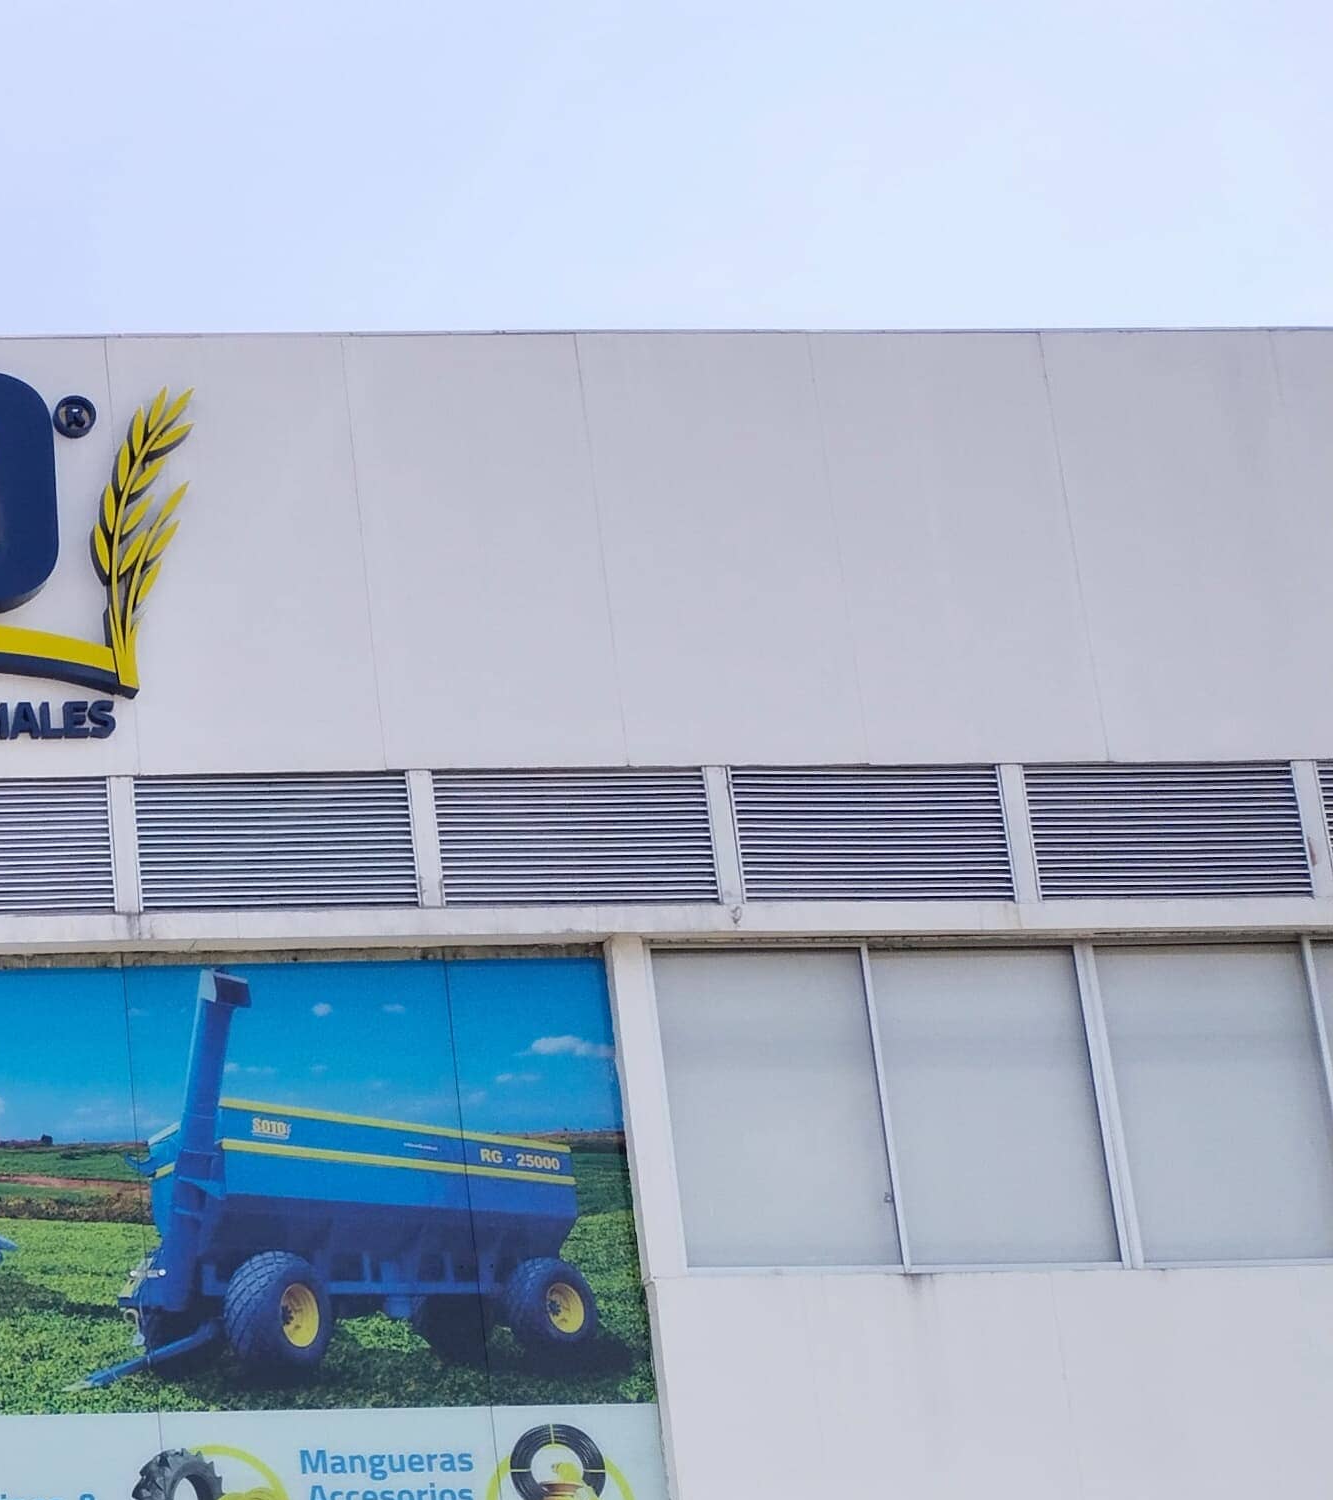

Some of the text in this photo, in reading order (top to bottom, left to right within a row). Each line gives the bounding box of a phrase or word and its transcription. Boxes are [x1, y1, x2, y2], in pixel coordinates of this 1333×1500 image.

[479, 1147, 504, 1164] RG
[515, 1153, 561, 1172] 25000
[299, 1449, 474, 1481] Mangueras
